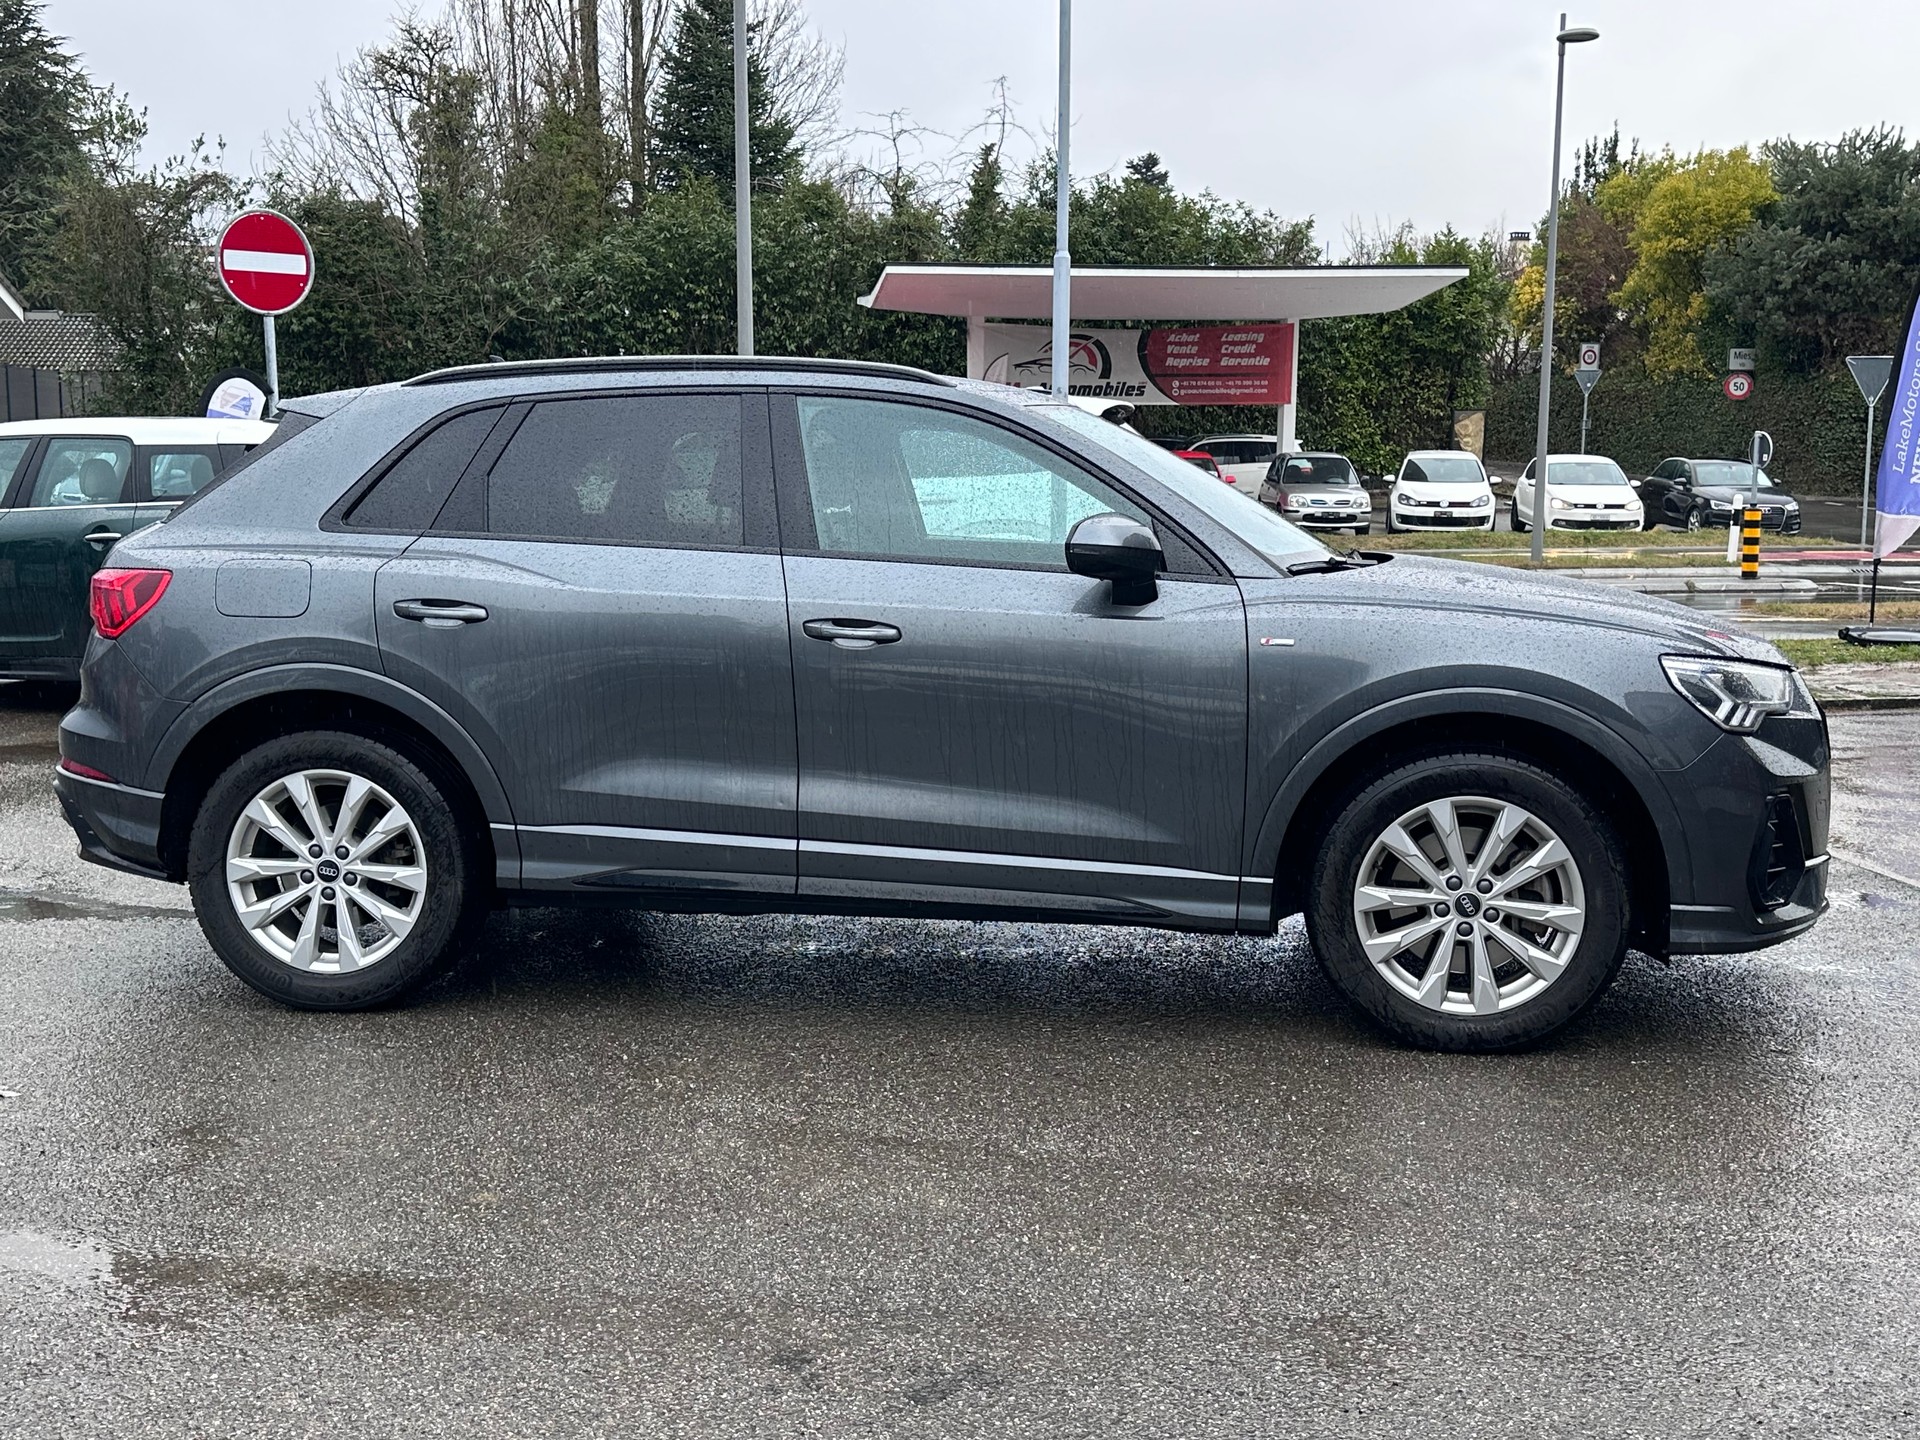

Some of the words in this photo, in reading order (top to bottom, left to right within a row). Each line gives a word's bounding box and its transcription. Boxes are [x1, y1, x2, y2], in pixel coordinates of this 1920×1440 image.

[1167, 333, 1200, 342] Achat
[1221, 332, 1265, 343] Leasing
[1166, 344, 1198, 354] Vente
[1221, 343, 1257, 353] Credit
[1165, 356, 1210, 368] Reprise
[1220, 355, 1271, 366] Garantie
[1040, 382, 1147, 397] omobiles
[1733, 382, 1745, 391] 50
[1892, 358, 1920, 474] LakeMotors
